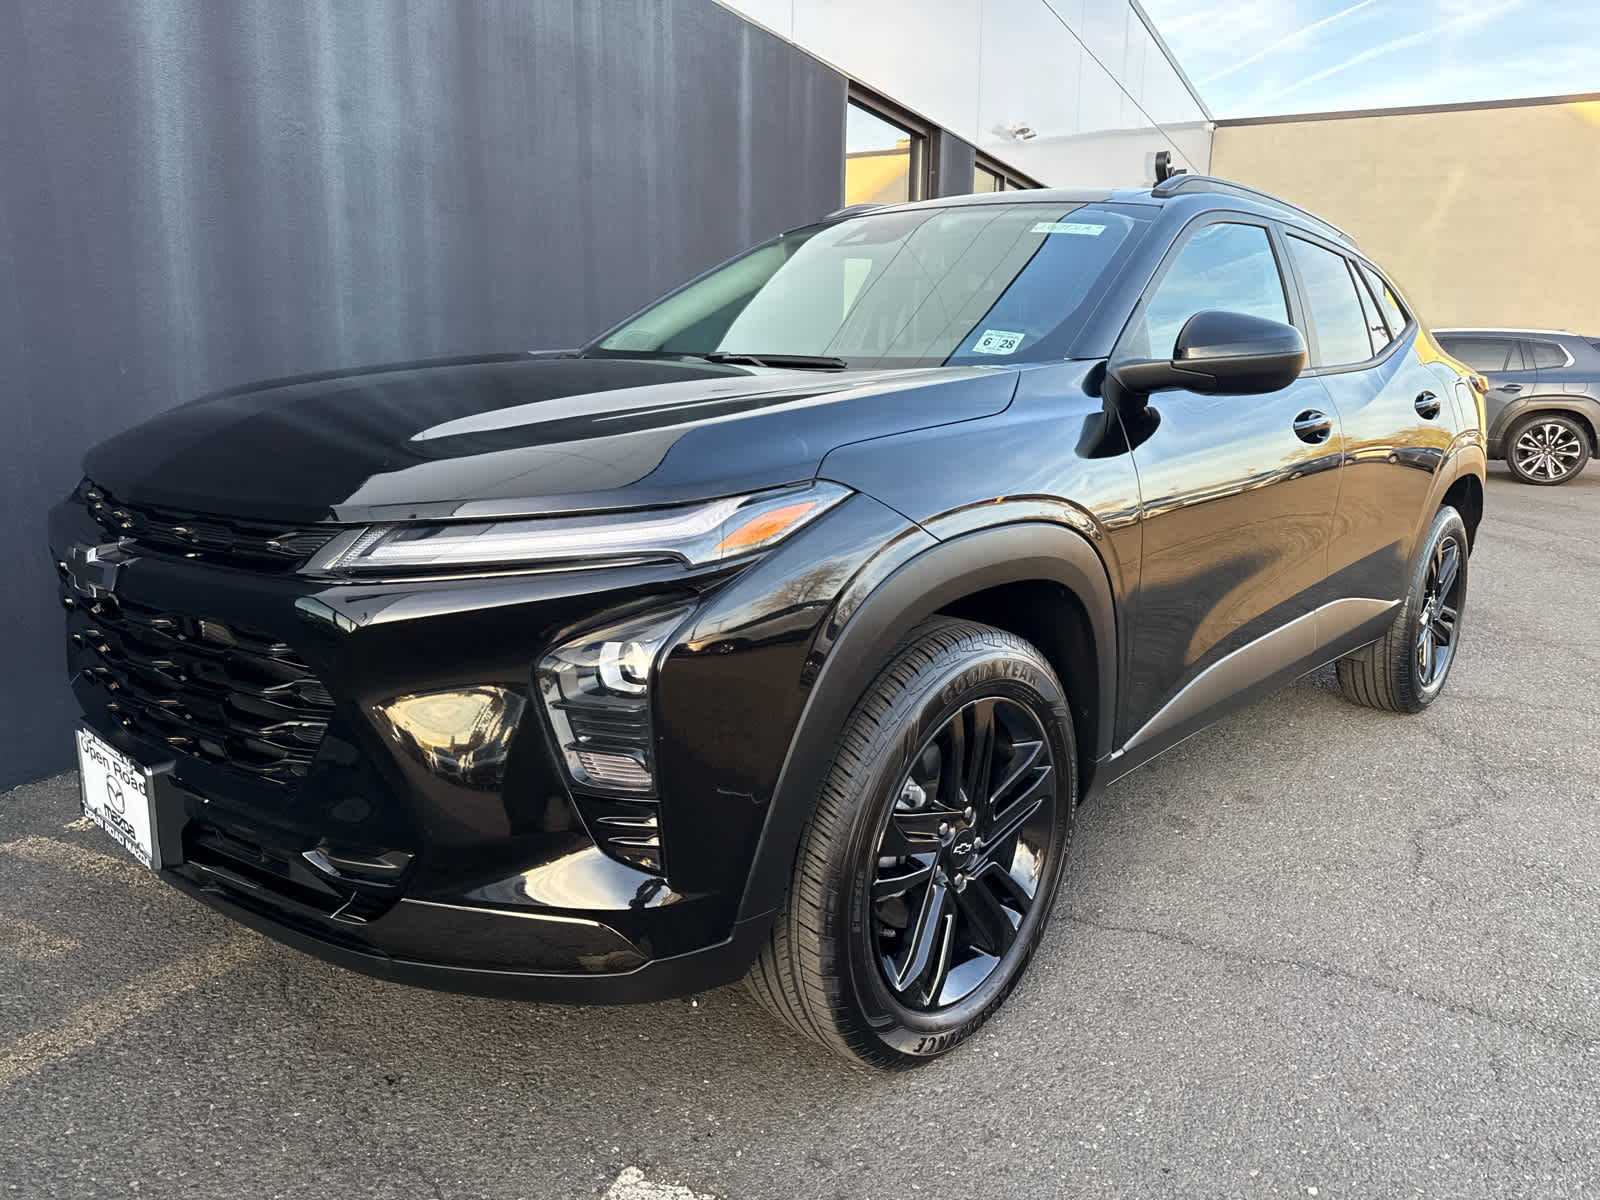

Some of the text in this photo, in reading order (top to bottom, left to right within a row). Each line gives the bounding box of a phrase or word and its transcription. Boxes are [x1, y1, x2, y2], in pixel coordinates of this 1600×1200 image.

[983, 337, 993, 346] 6
[999, 339, 1016, 349] 28
[80, 735, 111, 770] Open
[113, 761, 147, 796] Road
[84, 807, 152, 870] OPEN ROAD MAZDA
